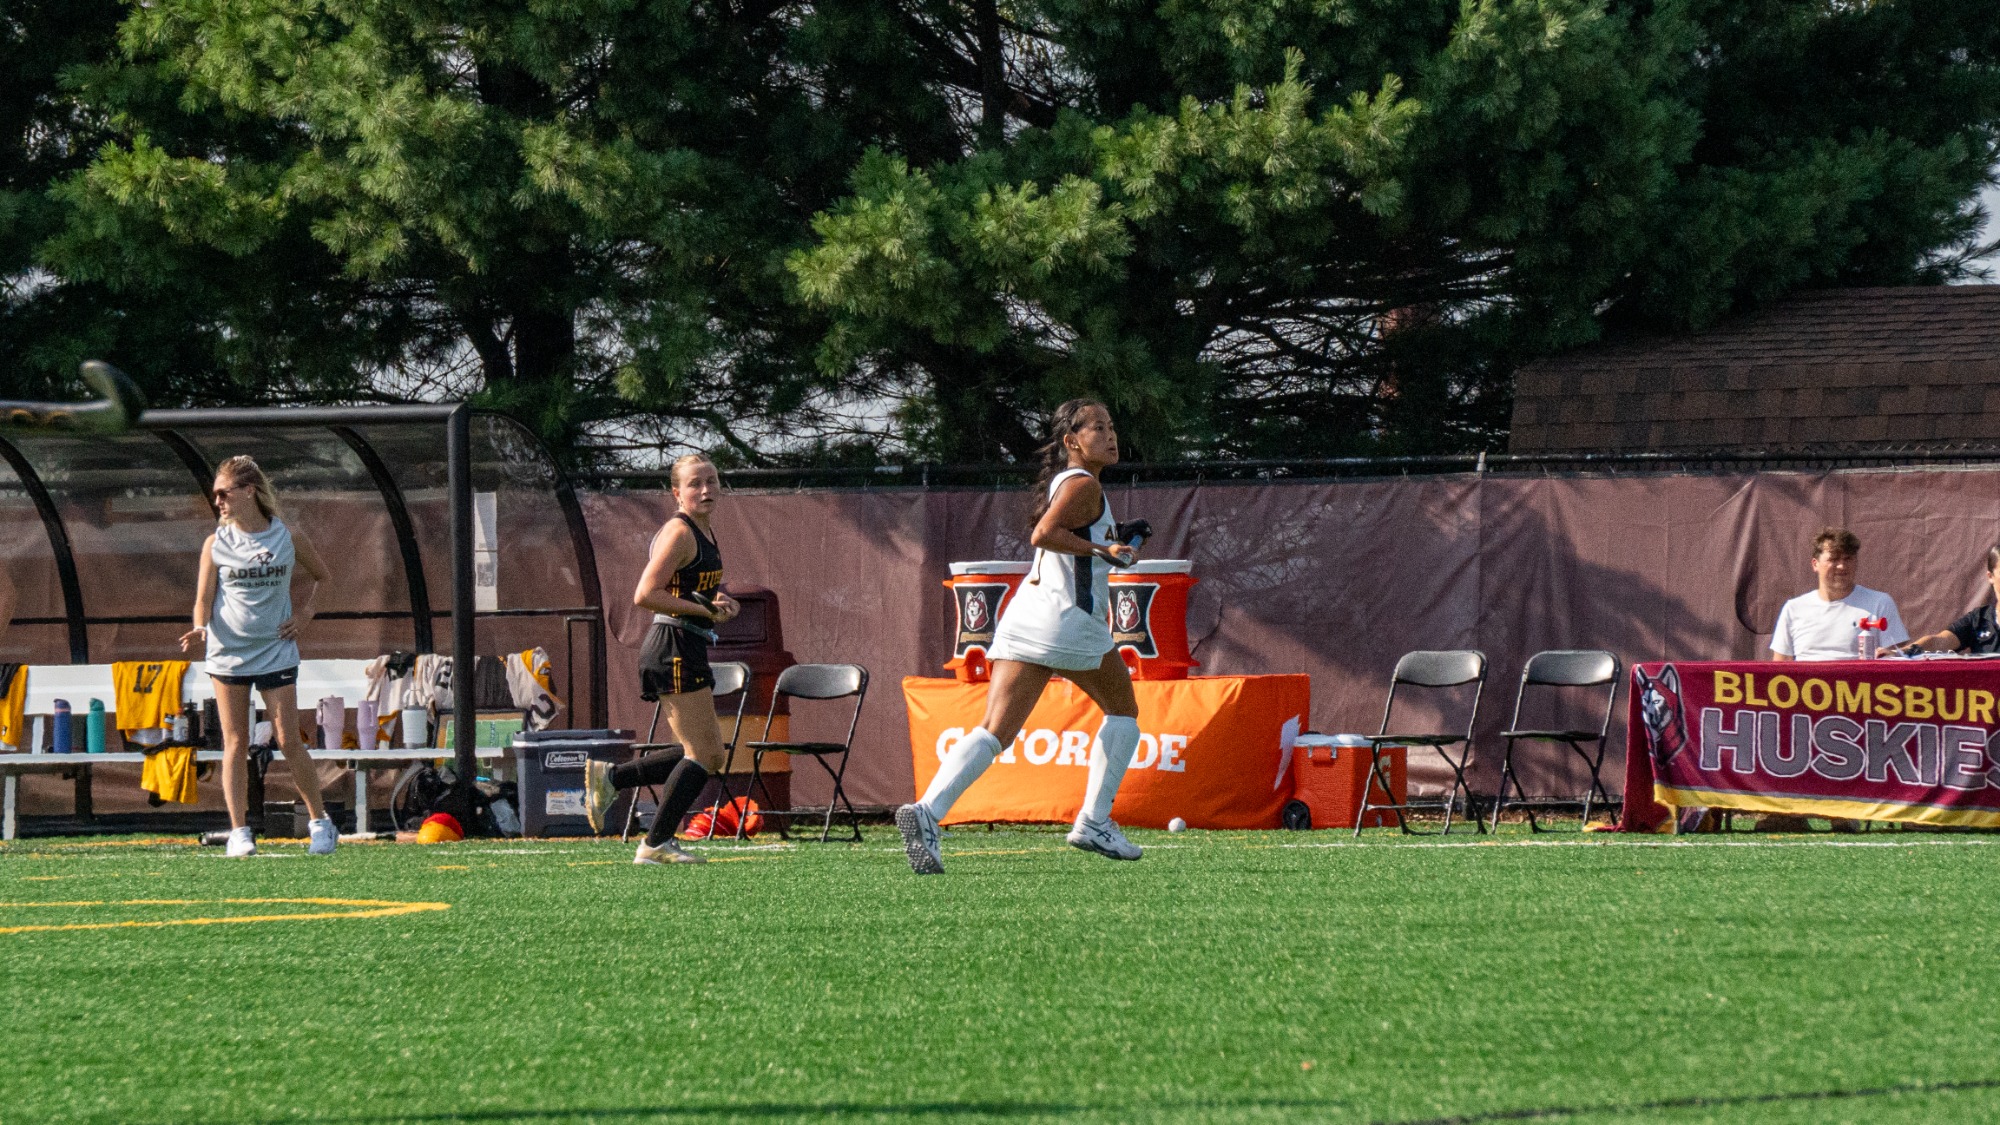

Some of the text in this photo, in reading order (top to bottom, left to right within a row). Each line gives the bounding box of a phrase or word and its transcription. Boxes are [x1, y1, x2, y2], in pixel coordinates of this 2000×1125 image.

[229, 565, 287, 579] ADELPHI
[133, 664, 163, 693] 17
[1714, 670, 2000, 724] BLOOMSBUR
[936, 727, 1187, 773] GTORDE
